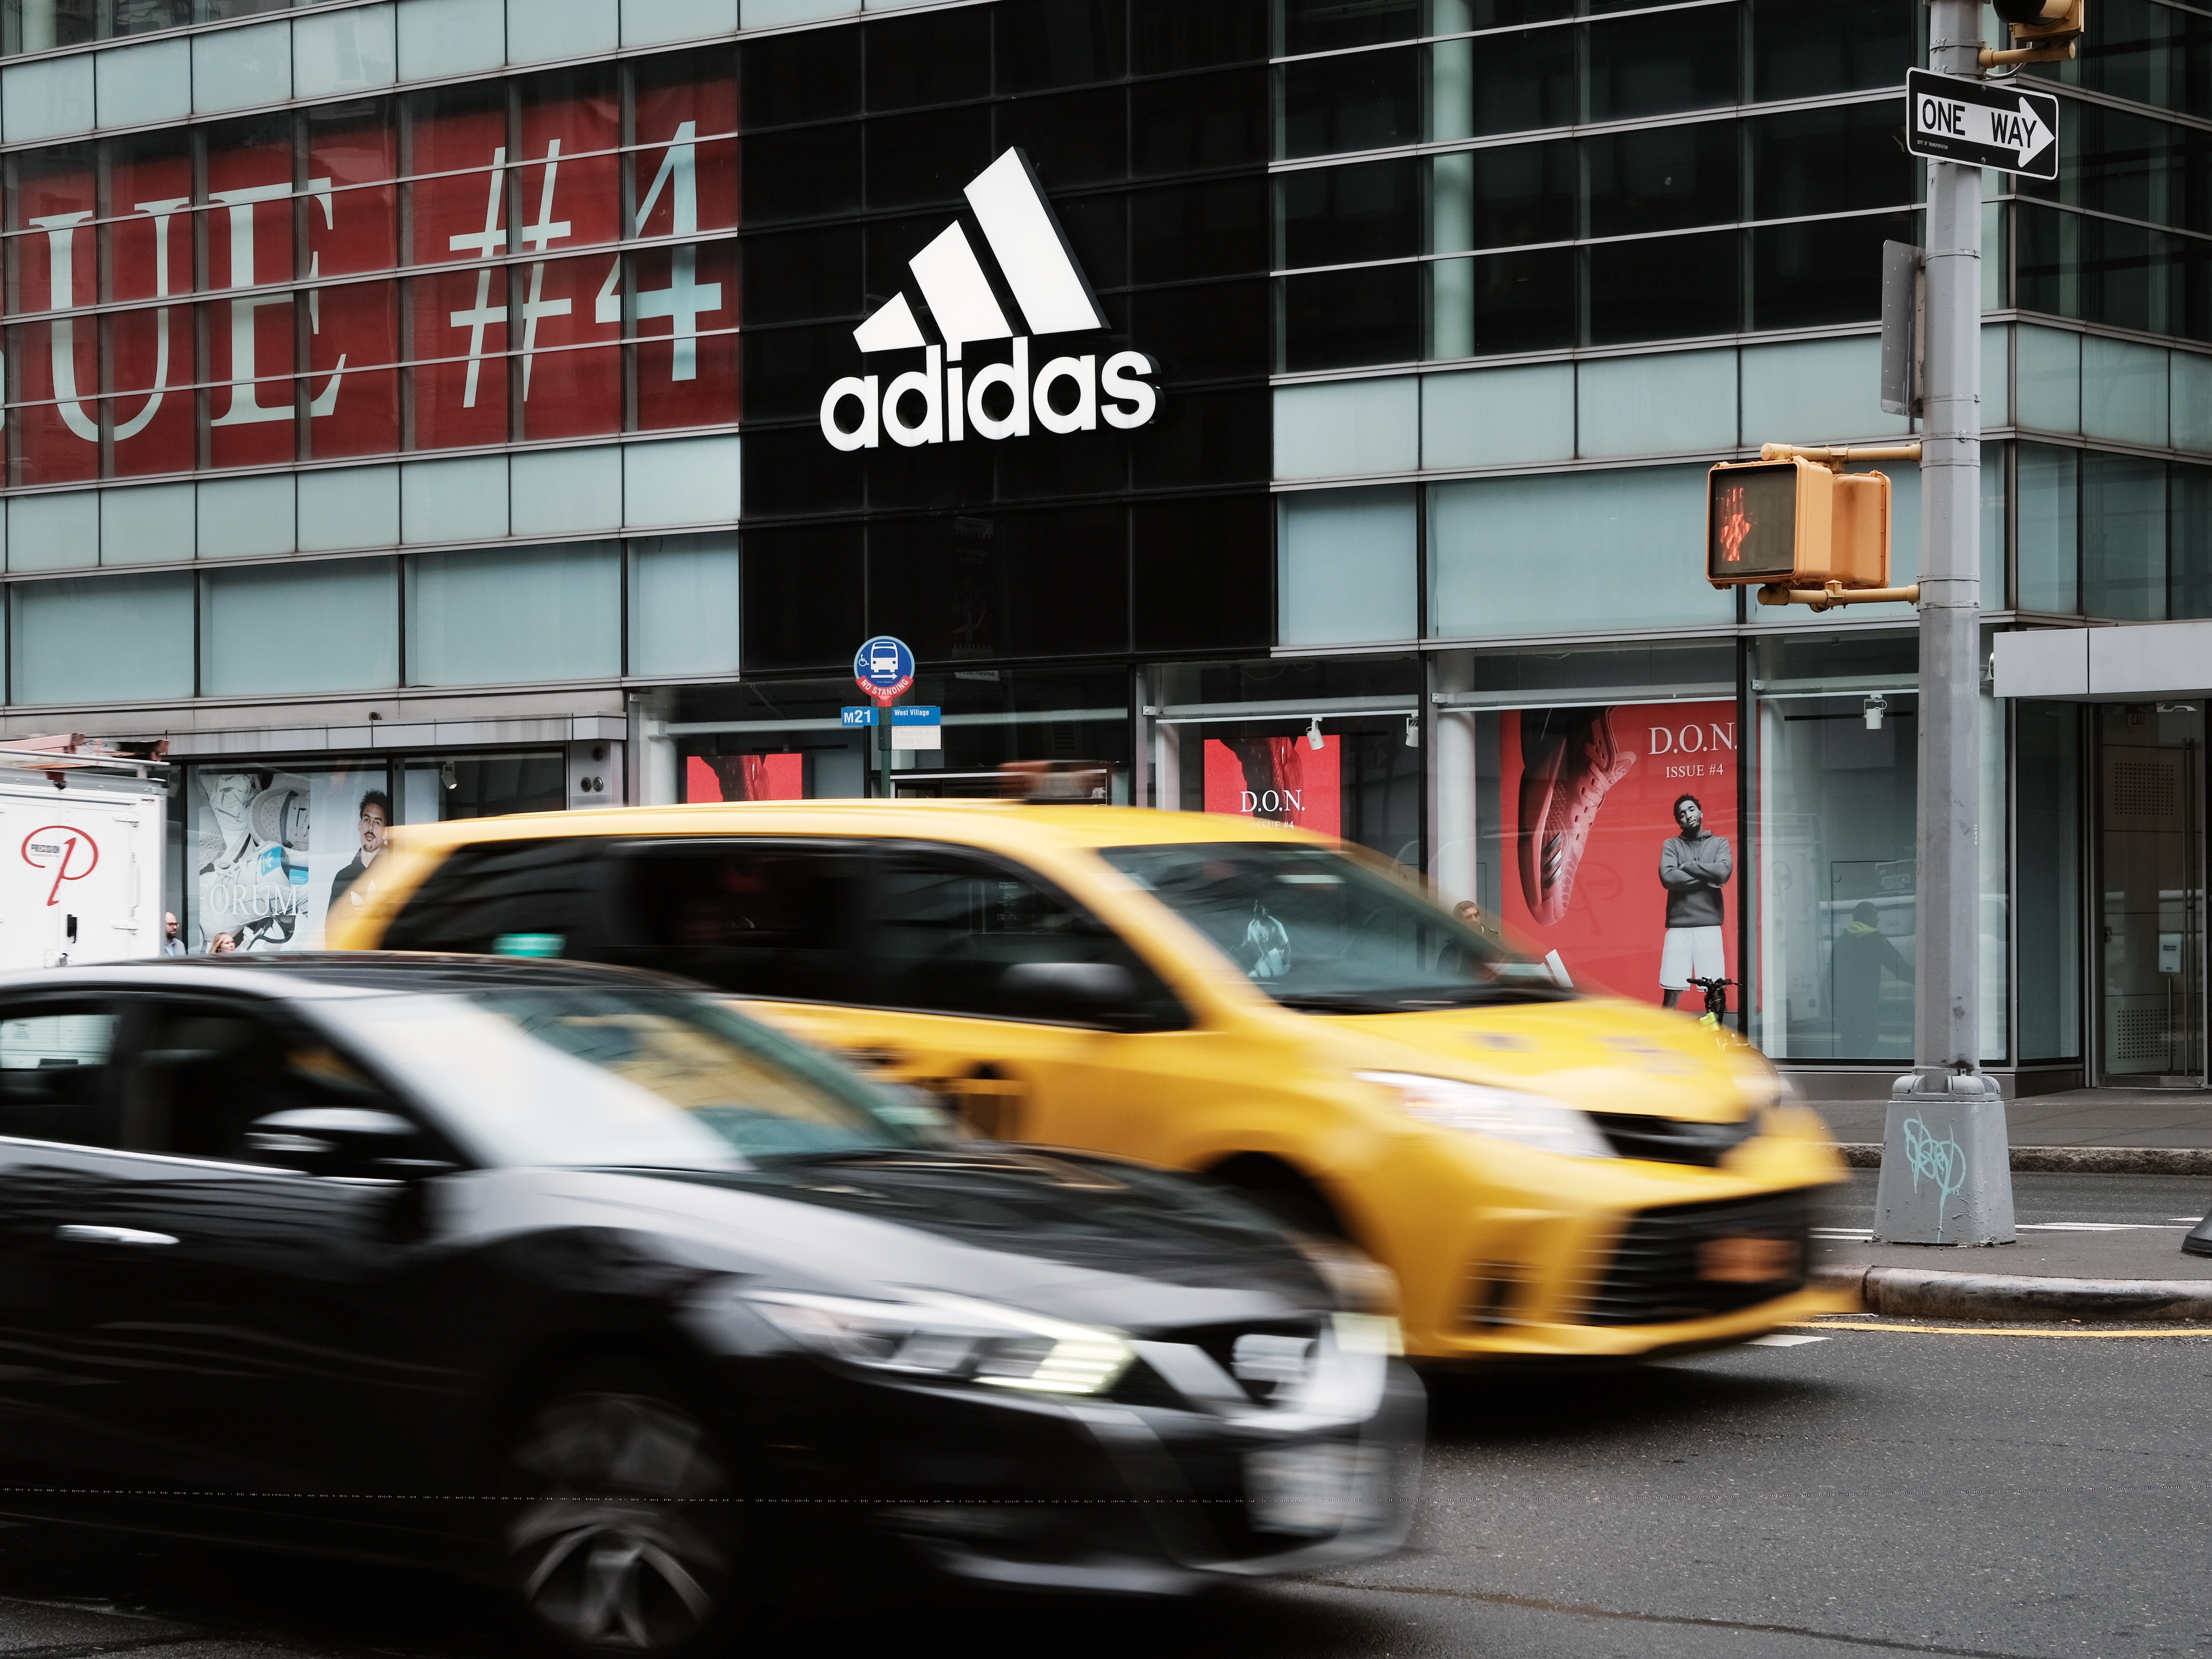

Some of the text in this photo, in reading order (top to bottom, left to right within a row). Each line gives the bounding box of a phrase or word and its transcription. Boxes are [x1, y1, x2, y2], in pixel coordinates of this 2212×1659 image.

[1923, 99, 2037, 148] ONE WAY
[0, 121, 722, 442] UE #4
[820, 337, 1158, 451] adidas
[861, 679, 909, 695] NO STANDING
[844, 710, 871, 723] M21
[1648, 722, 1737, 754] D.O.N.
[1666, 763, 1723, 778] ISSUE #4
[1240, 790, 1305, 812] D.O.N.
[1283, 820, 1294, 830] #4
